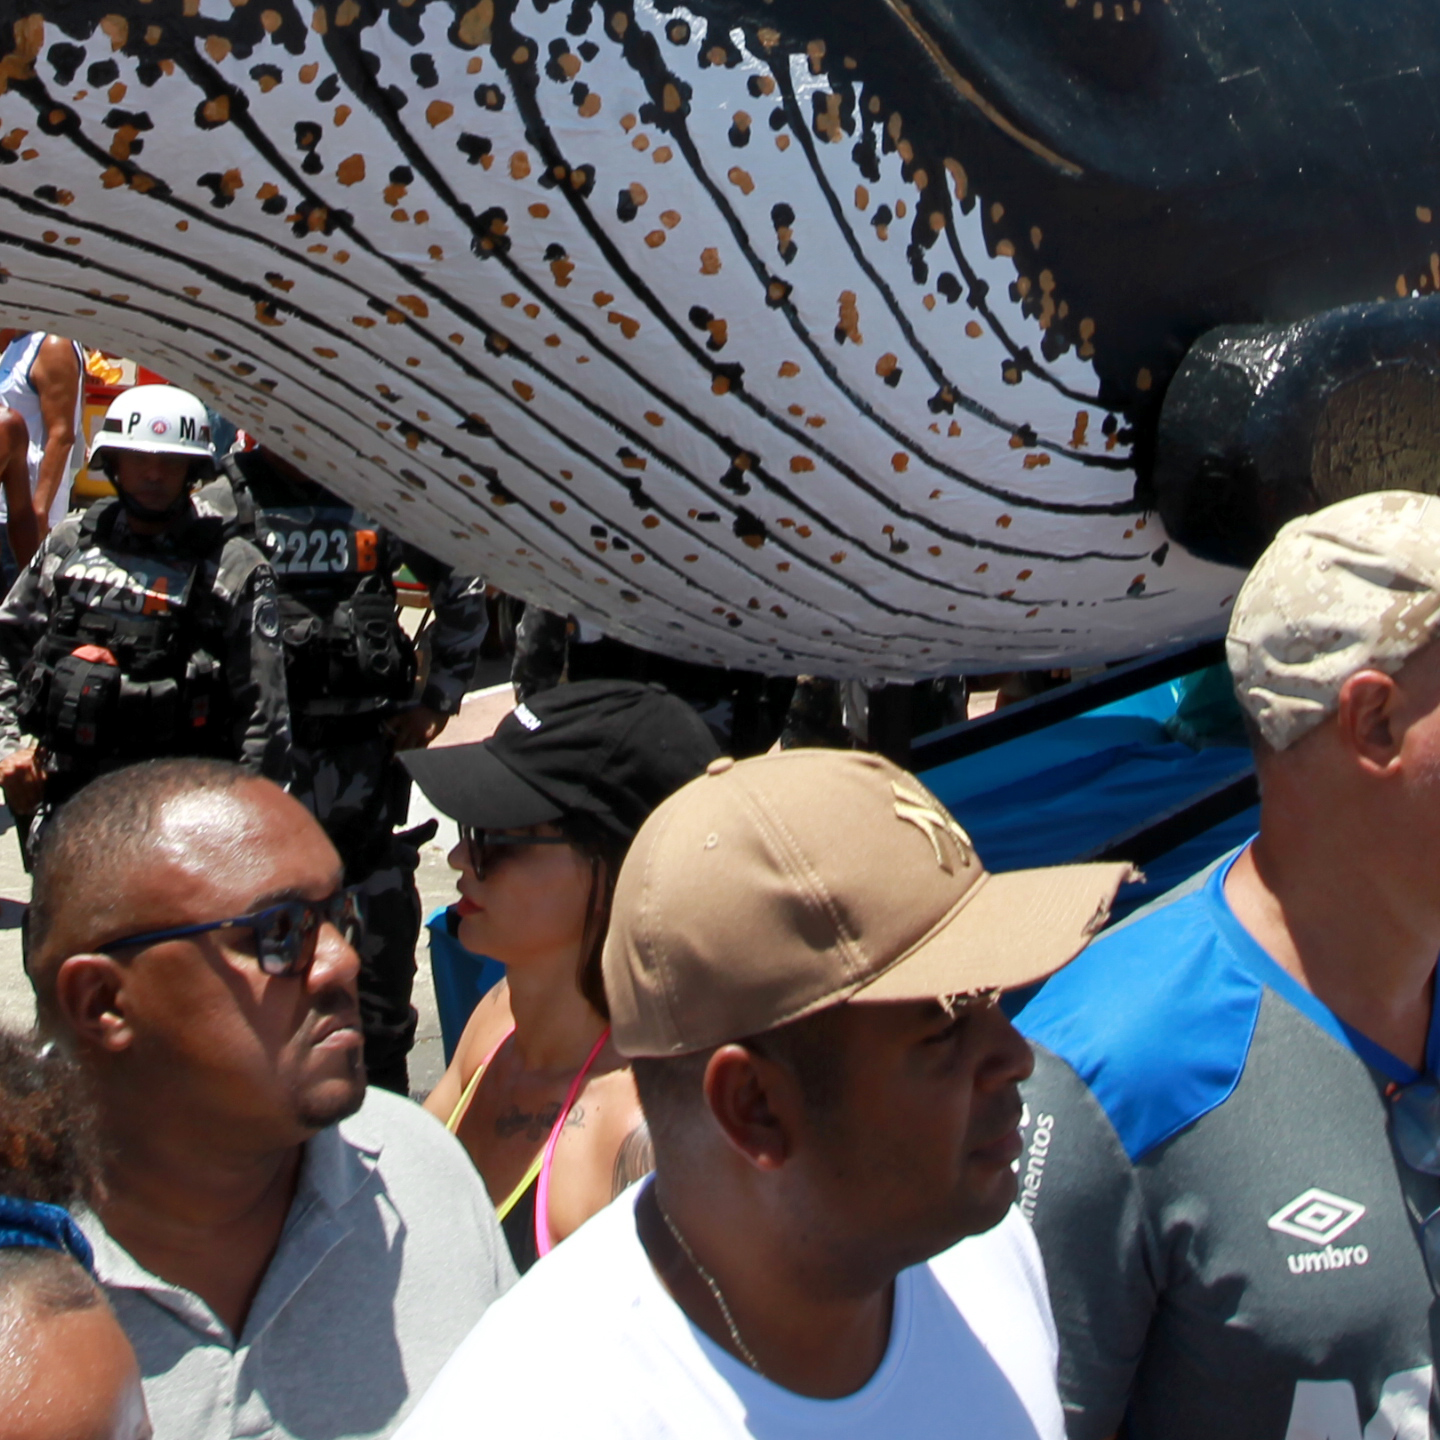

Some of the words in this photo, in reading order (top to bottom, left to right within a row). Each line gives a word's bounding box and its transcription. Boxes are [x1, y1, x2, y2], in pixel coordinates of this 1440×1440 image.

[127, 411, 142, 435] P
[180, 416, 196, 441] M
[266, 529, 349, 573] 2223
[355, 529, 378, 572] B
[1019, 1112, 1055, 1225] mentos
[1287, 1243, 1369, 1275] umbro
